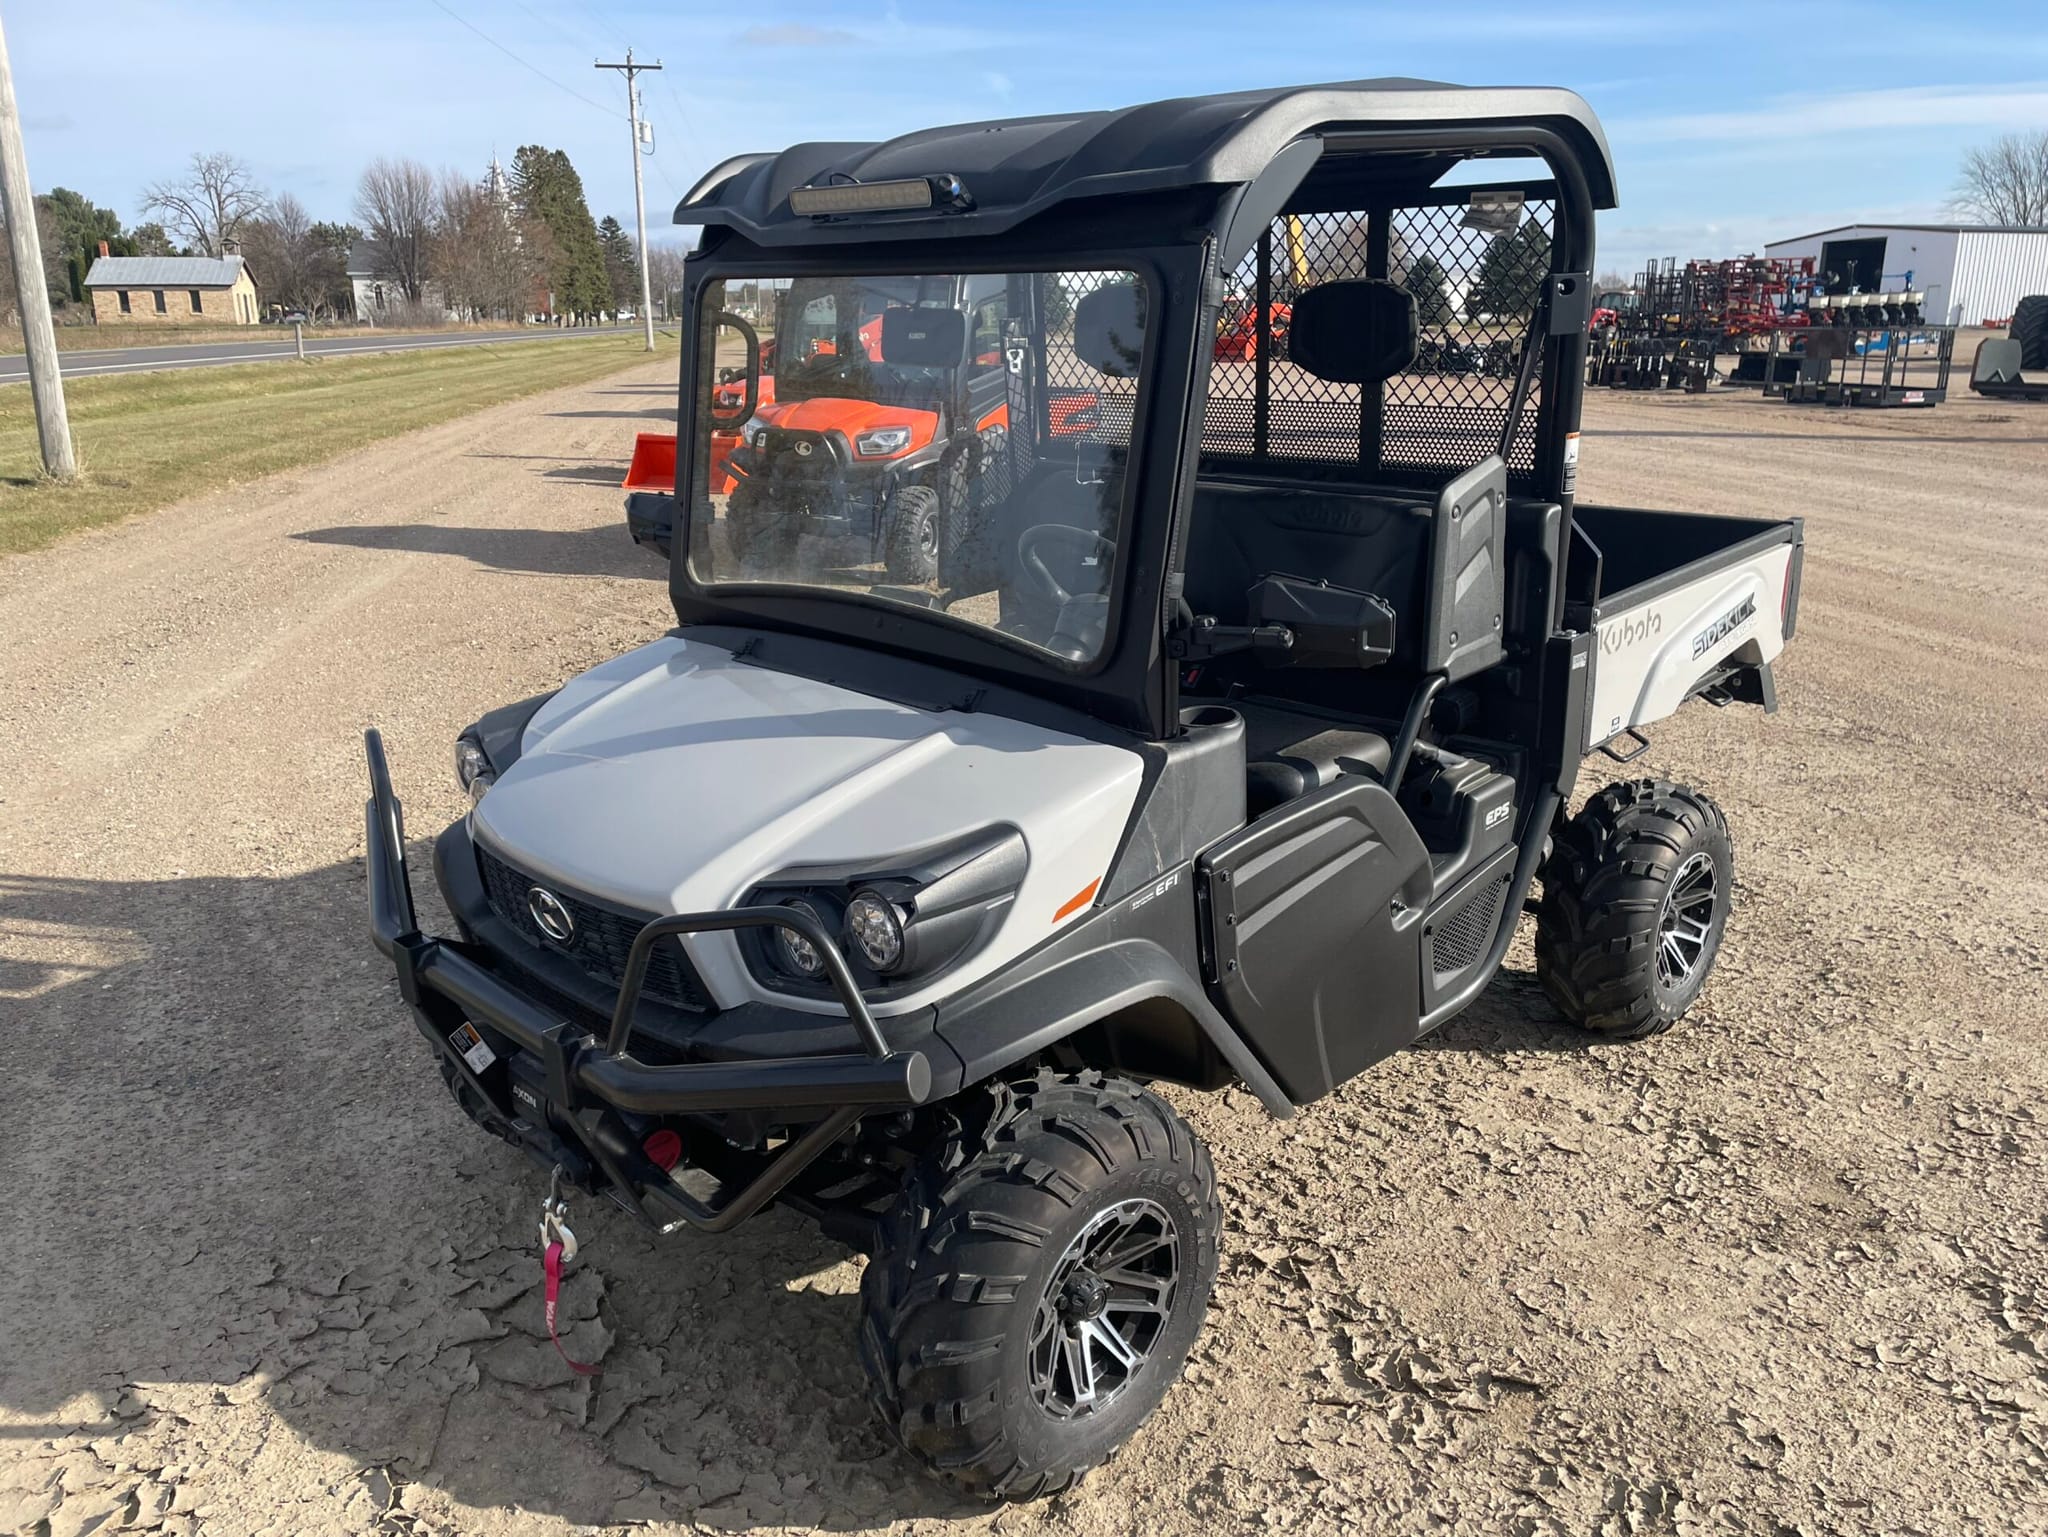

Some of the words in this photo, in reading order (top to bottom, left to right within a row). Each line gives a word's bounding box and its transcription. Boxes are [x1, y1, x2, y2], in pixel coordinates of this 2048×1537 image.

[1600, 607, 1662, 655] Kubota
[1692, 591, 1757, 662] SIDEKICK
[1485, 801, 1511, 826] EPS
[1155, 873, 1179, 897] EFI
